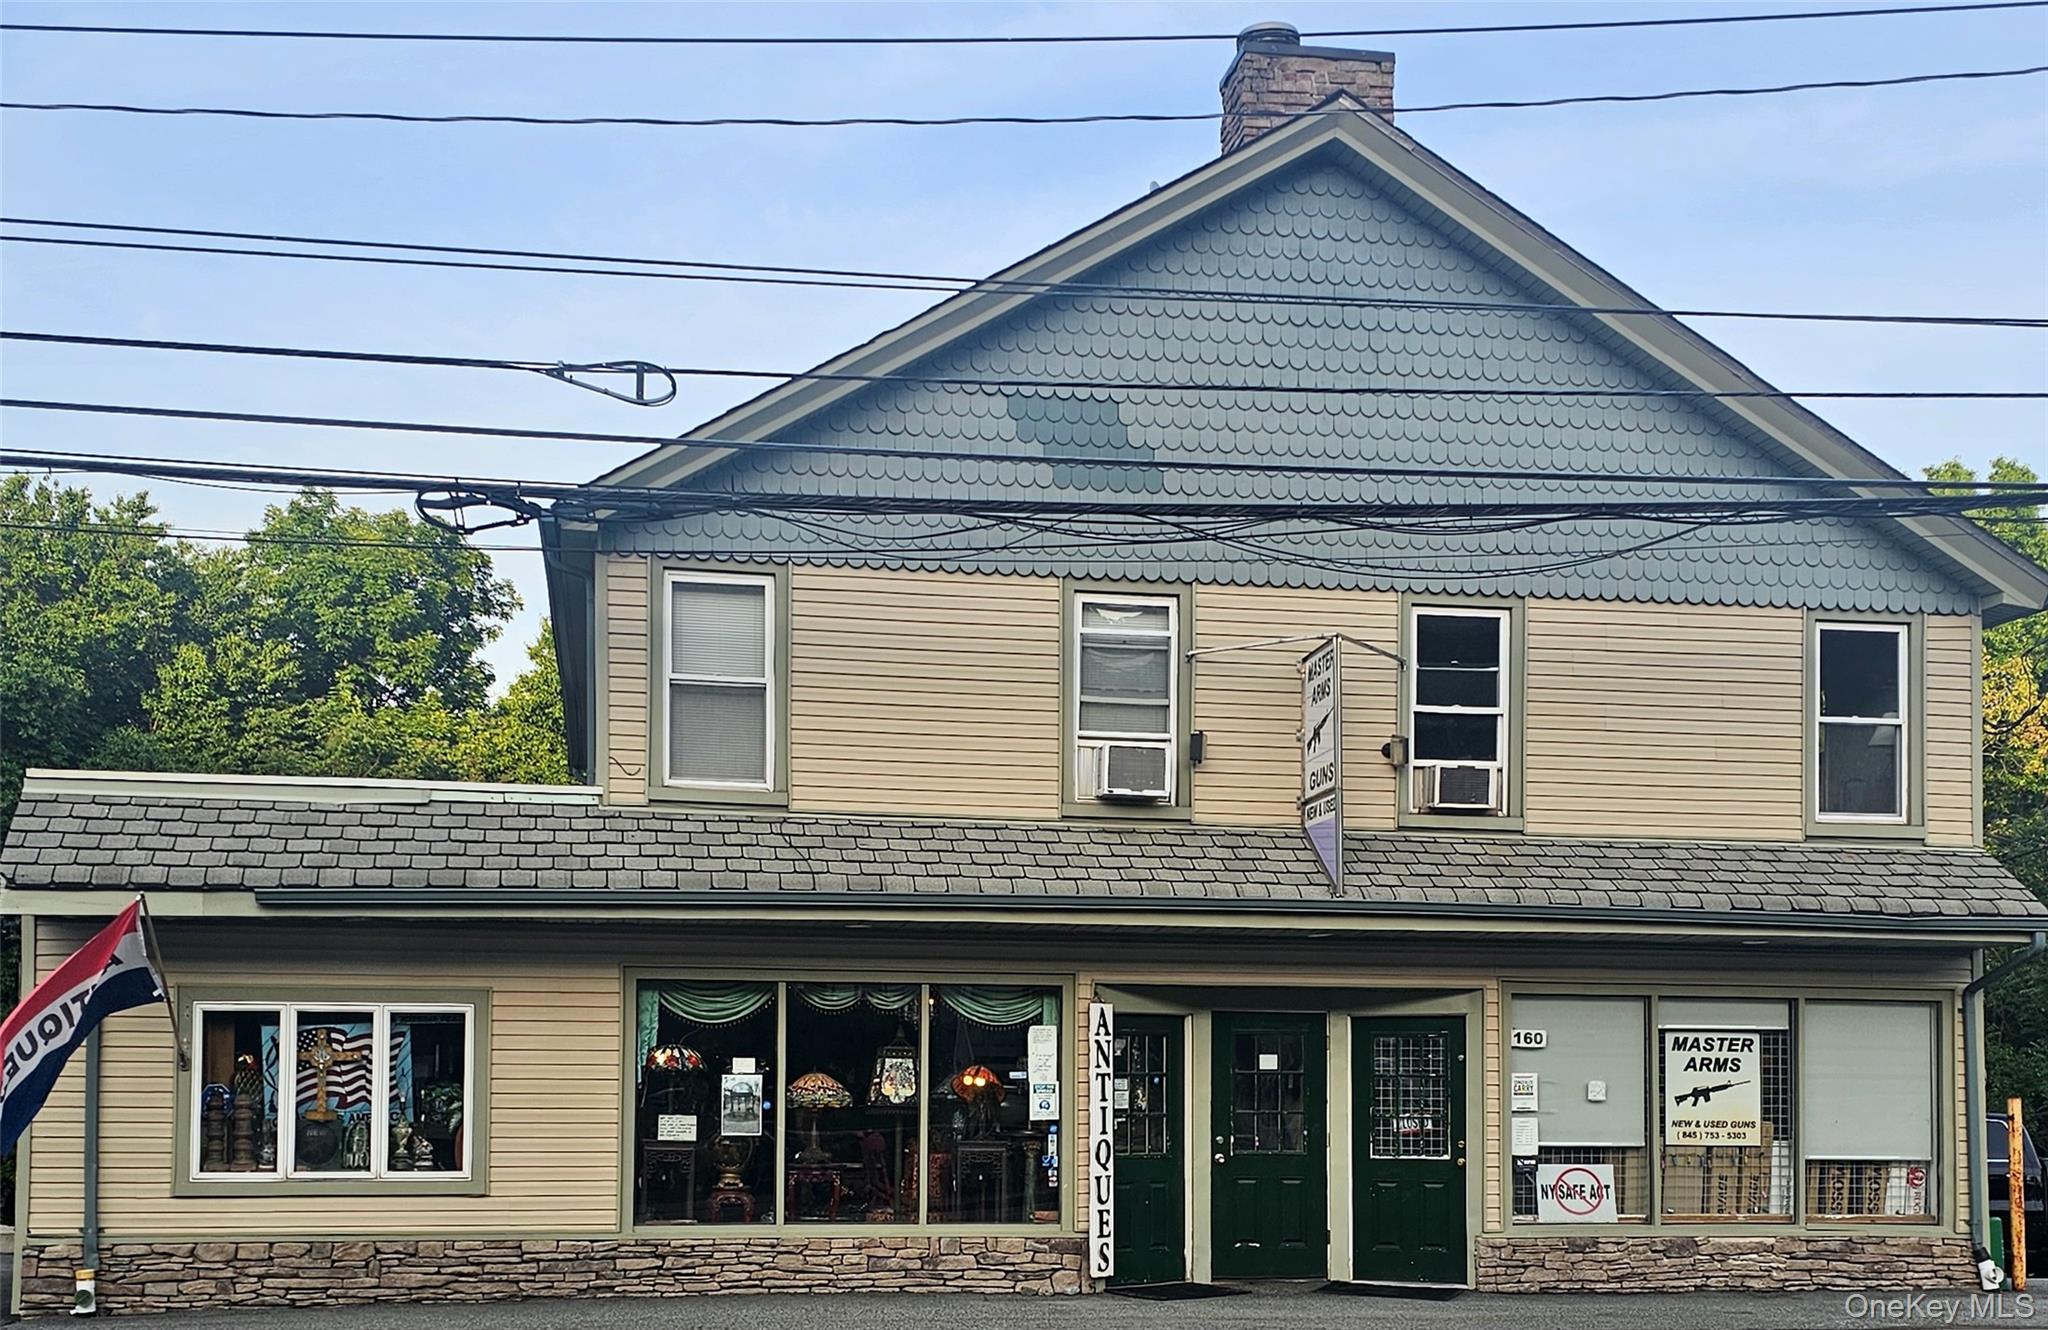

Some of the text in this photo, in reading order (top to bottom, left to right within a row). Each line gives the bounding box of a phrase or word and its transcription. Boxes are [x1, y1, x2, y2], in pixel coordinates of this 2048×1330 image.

[1311, 677, 1331, 707] ARMS
[1310, 762, 1334, 790] GUNS
[1307, 803, 1317, 820] NEW
[1323, 797, 1336, 815] USE
[1513, 1031, 1544, 1045] 160
[1671, 1036, 1754, 1053] MASTER
[1683, 1056, 1742, 1073] ARMS
[1671, 1120, 1757, 1129] NEW & USED GUNS
[1094, 1006, 1112, 1273] ANTIQUES
[1540, 1184, 1611, 1200] NY SAFE ACT
